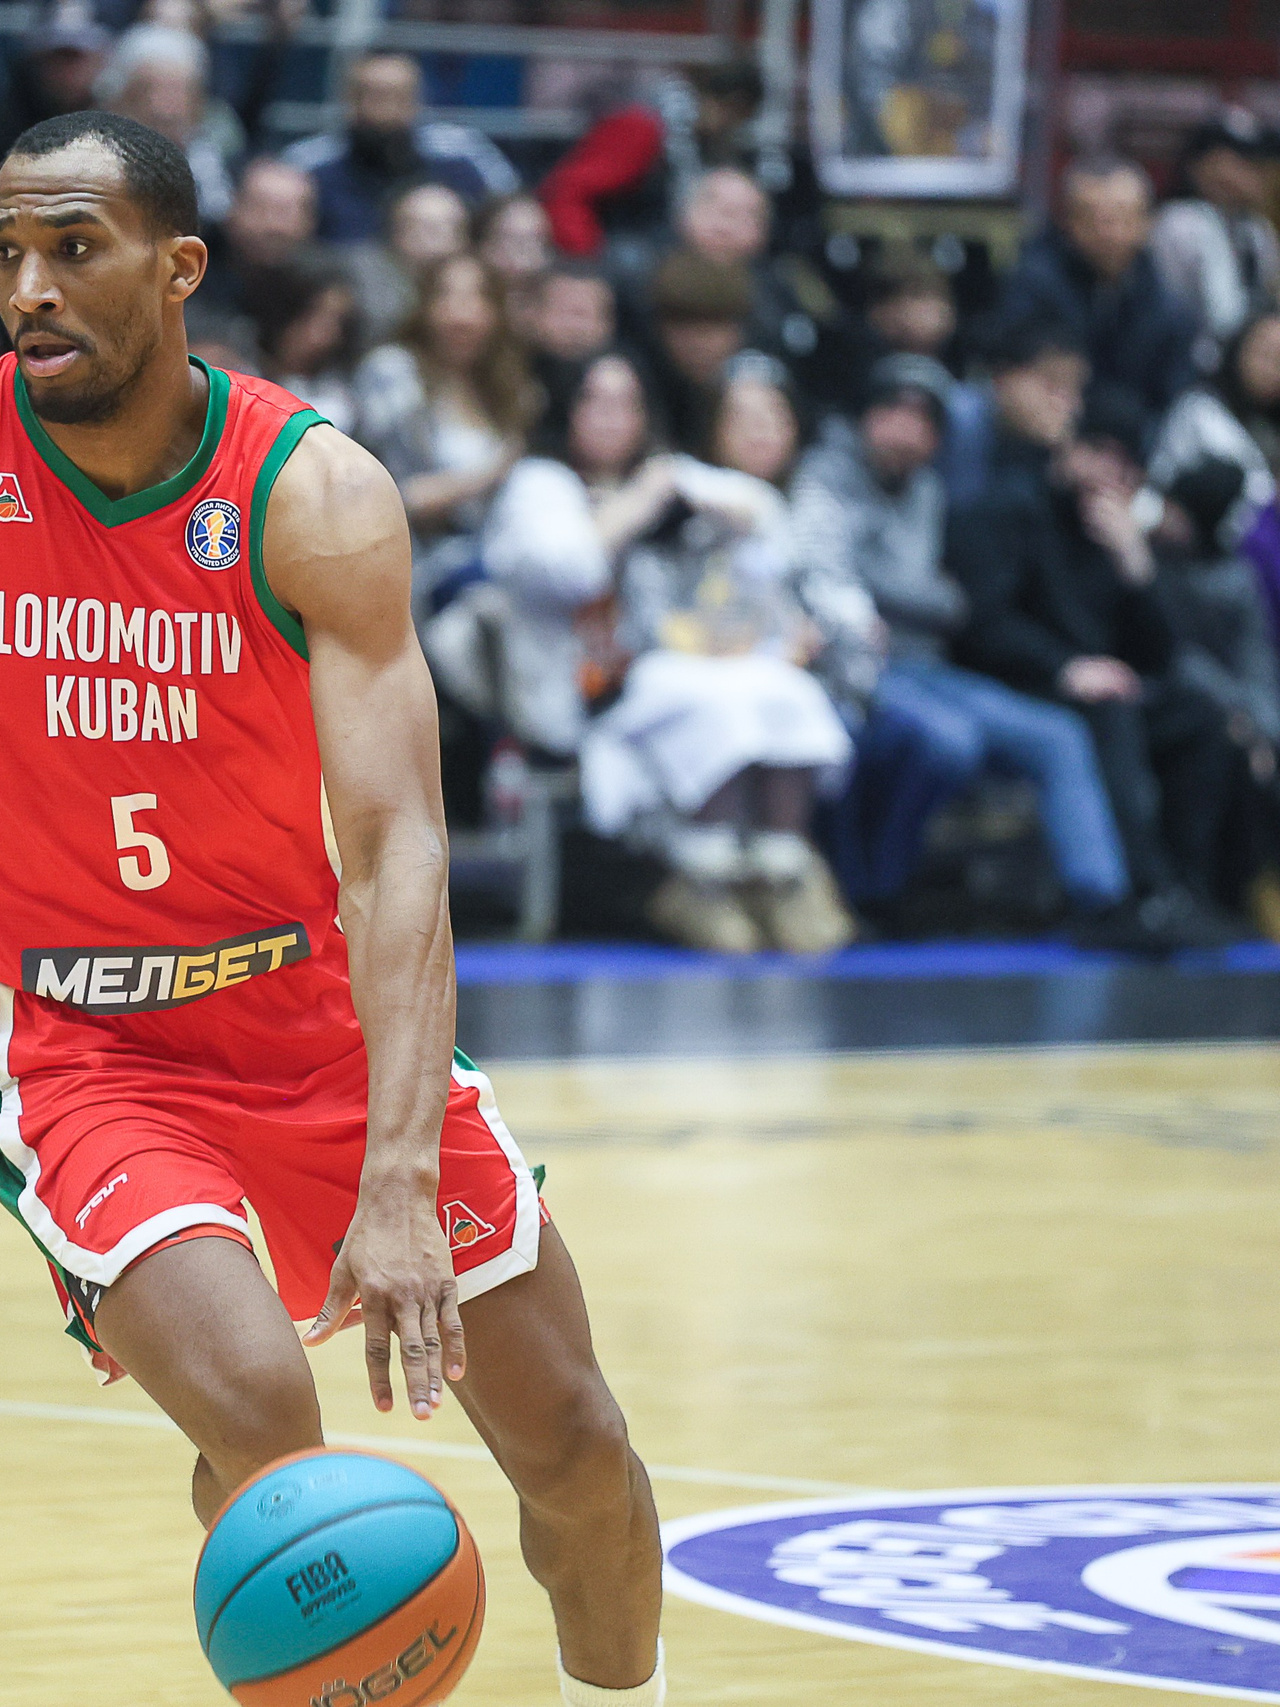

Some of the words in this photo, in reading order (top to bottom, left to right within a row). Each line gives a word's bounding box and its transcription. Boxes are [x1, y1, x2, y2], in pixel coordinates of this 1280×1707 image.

[215, 502, 232, 514] ЛИГА
[190, 545, 200, 559] VTB
[198, 555, 220, 567] UNITED
[220, 547, 240, 566] LEAGUE
[45, 674, 198, 744] KUBAN
[110, 792, 171, 891] 5
[35, 933, 298, 1005] МЕЛБЕТ
[285, 1550, 349, 1605] FIBA
[310, 1619, 458, 1707] ÖGEL
